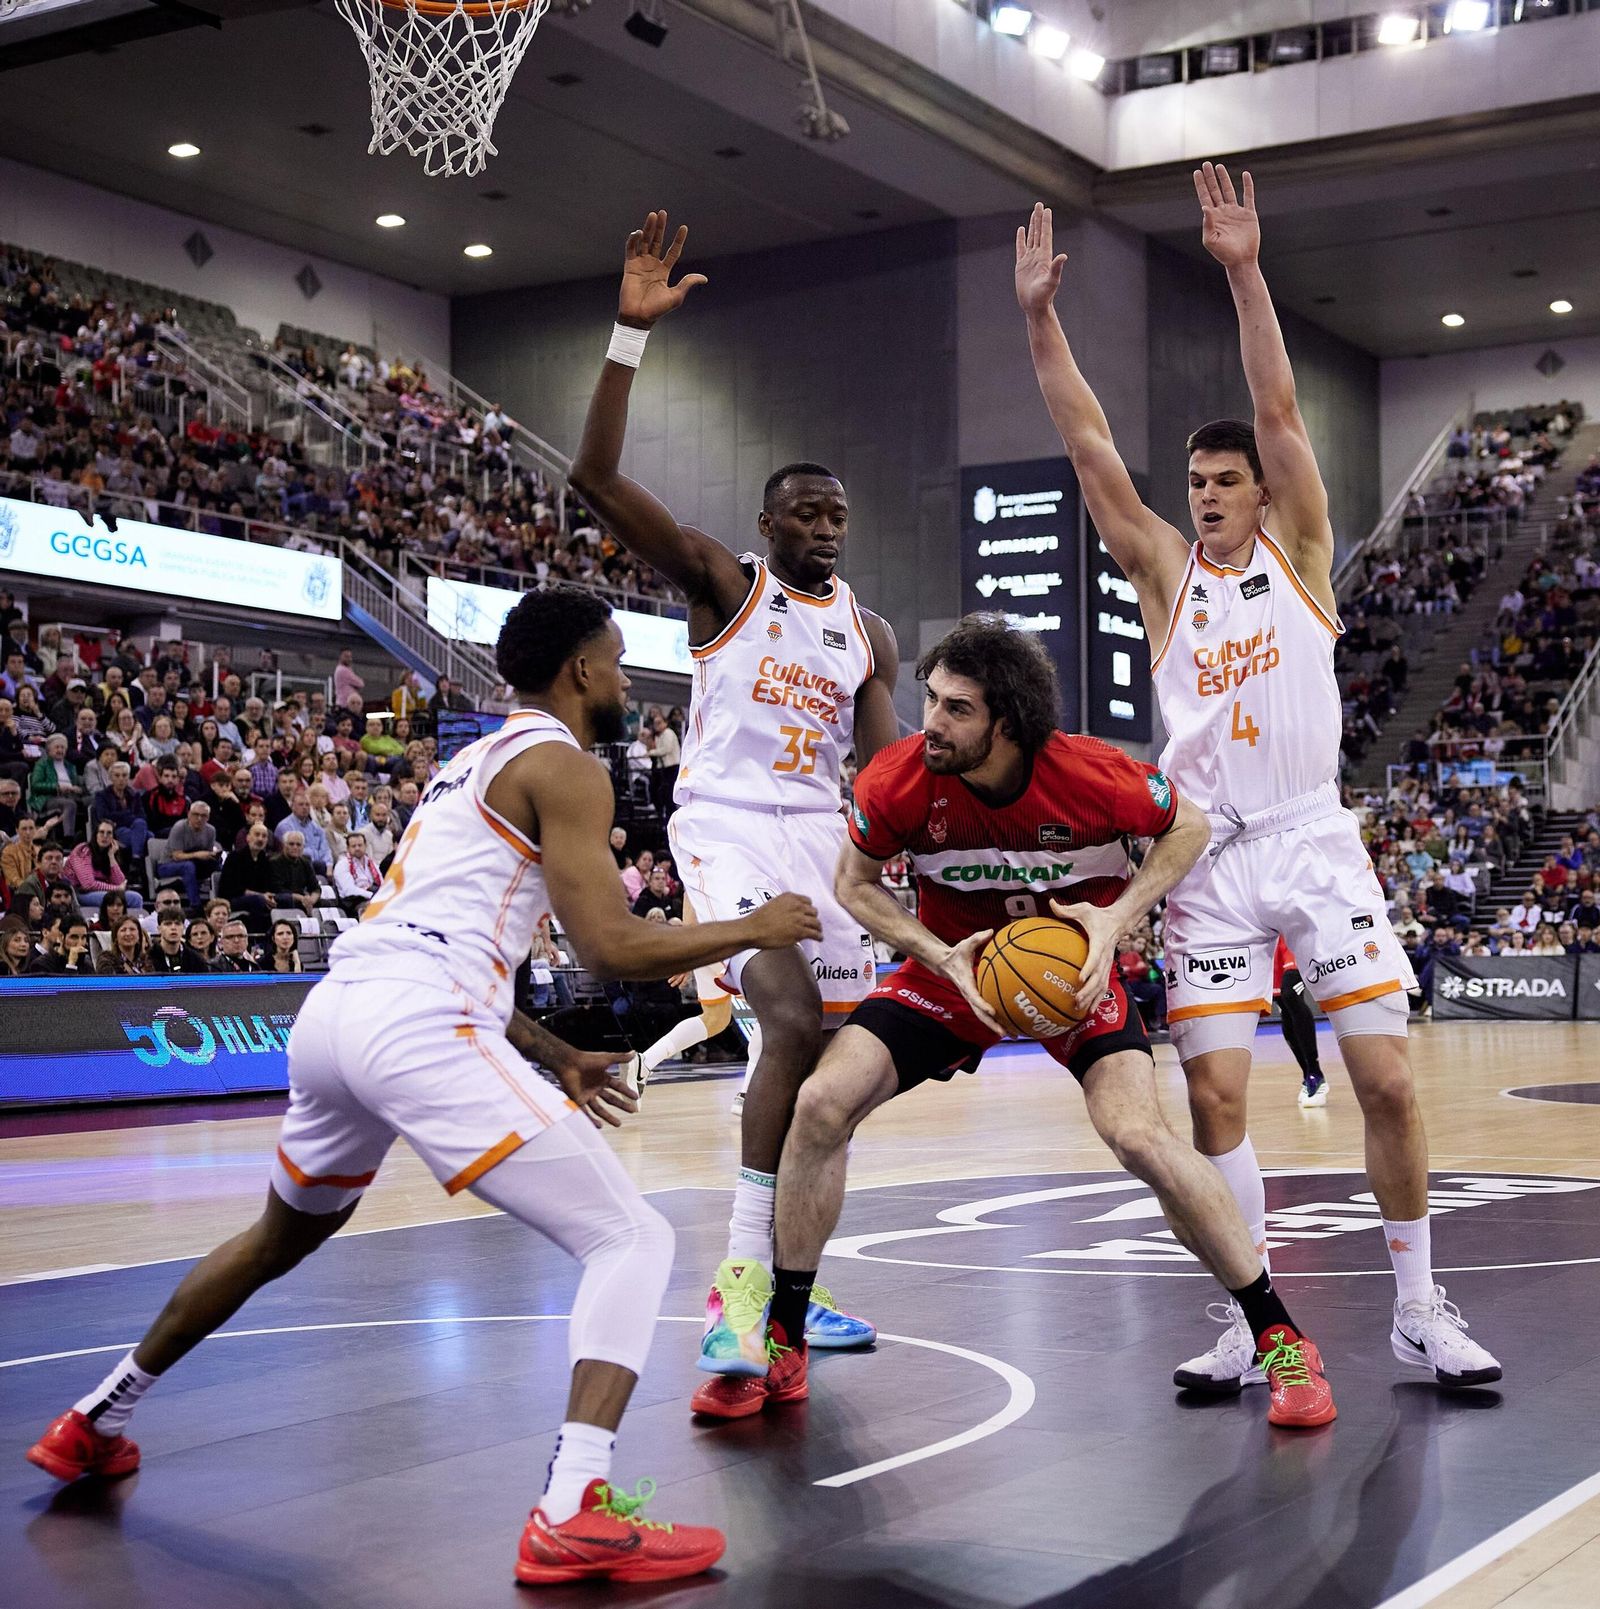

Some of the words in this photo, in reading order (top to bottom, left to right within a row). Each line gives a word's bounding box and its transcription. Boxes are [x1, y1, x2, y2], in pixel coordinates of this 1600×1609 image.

[1198, 647, 1279, 696] Esfurzo
[1231, 701, 1260, 747] 4
[772, 725, 824, 774] 35
[1043, 970, 1077, 996] ndesa
[1188, 955, 1246, 973] PULEVA
[1466, 978, 1567, 998] STRADA
[211, 1015, 283, 1054] HLA
